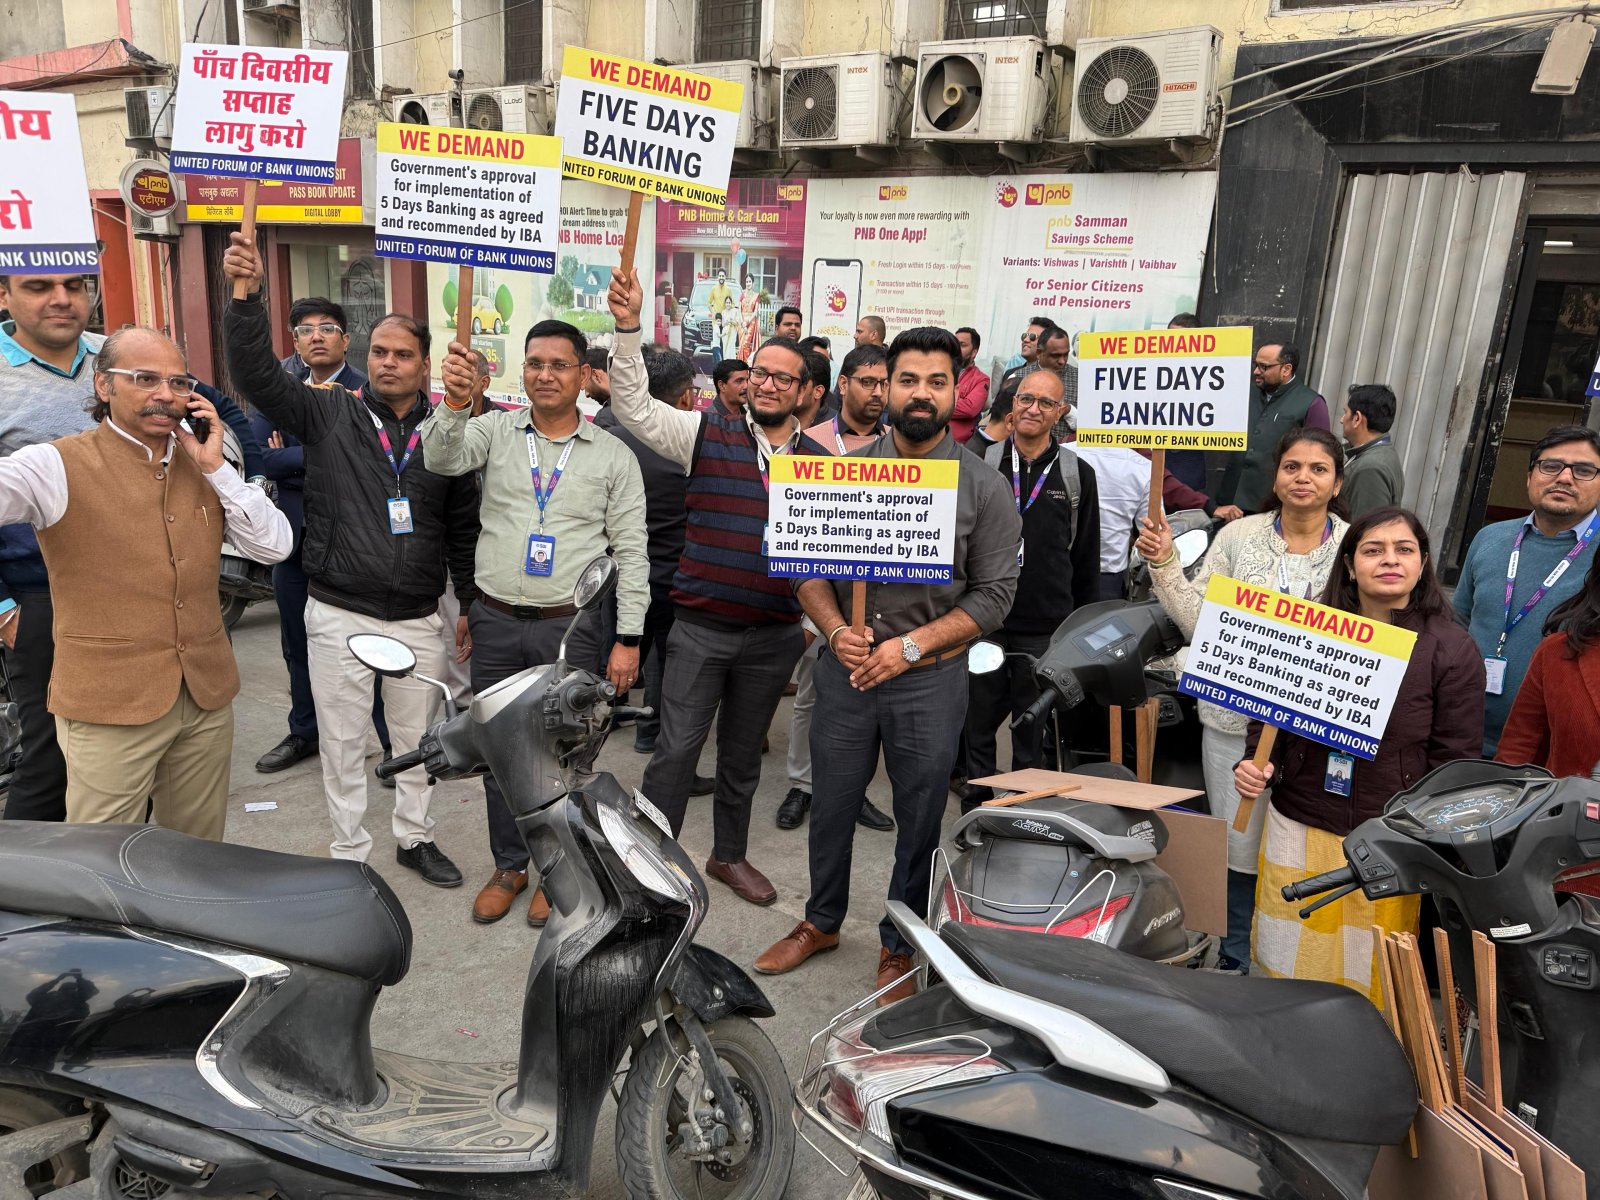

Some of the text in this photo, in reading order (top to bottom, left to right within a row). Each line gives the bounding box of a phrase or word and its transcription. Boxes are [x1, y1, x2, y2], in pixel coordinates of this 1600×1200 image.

[241, 52, 333, 84] दिवसीय
[590, 58, 711, 101] WE DEMAND
[223, 90, 295, 115] सप्ताह
[579, 90, 716, 142] FIVE DAYS
[205, 119, 307, 152] लागु करो
[400, 129, 525, 160] WE DEMAND
[583, 130, 702, 178] BANKING
[174, 156, 335, 178] UNITED FORUM OF BANK UNIONS
[391, 159, 536, 185] Government's approval
[150, 180, 168, 189] pnb
[289, 186, 356, 198] PASS BOOK UPDATE
[394, 178, 532, 203] for implementation of
[563, 161, 726, 206] NITED FORUM OF BANK UNIONS
[788, 188, 802, 198] pnb
[139, 195, 166, 206] एटीएम
[891, 188, 907, 199] pnb
[1045, 187, 1071, 202] pnb
[304, 209, 341, 217] DIGITAL LOBBY
[381, 196, 543, 224] 5 Days Banking as agreed
[586, 207, 600, 215] Time
[602, 208, 607, 216] to
[610, 208, 623, 218] grab
[679, 209, 779, 223] PNB Home & Car Loan
[820, 211, 833, 220] Your
[835, 212, 855, 222] loyalty
[917, 212, 952, 222] rewarding
[954, 211, 970, 220] with
[381, 217, 542, 243] and recommended by IBA
[563, 218, 580, 226] dream
[582, 219, 605, 227] address
[718, 224, 741, 237] More
[1075, 215, 1127, 227] Samman
[560, 230, 623, 245] NB Home Loa
[855, 227, 927, 243] PNB One App!
[1051, 234, 1133, 245] Savings Scheme
[0, 250, 98, 266] NK UNIONS
[376, 239, 553, 268] UNITED FORUM OF BANK UNIONS
[1003, 257, 1177, 269] Variants: Vishwas Varishth Vaibhav
[1026, 278, 1143, 293] for Senior Citizens
[1033, 296, 1131, 309] and Pensioners
[1100, 335, 1215, 354] WE DEMAND
[1095, 366, 1225, 391] FIVE DAYS
[1101, 402, 1214, 426] BANKING
[1079, 434, 1243, 447] UNITED FORUM OF BANK UNIONS
[793, 461, 921, 483] WE DEMAND
[775, 522, 940, 541] 5 Days Banking as agreed
[776, 540, 938, 558] and recommended by IBA
[1235, 586, 1374, 644] WE DEMAND
[1219, 611, 1381, 671] Government's approval
[1219, 629, 1371, 687] for implementation of
[1200, 642, 1379, 711] 5 Days Banking as agreed
[1197, 660, 1372, 727] and recommended by IBA
[1012, 820, 1048, 836] ACTIVA
